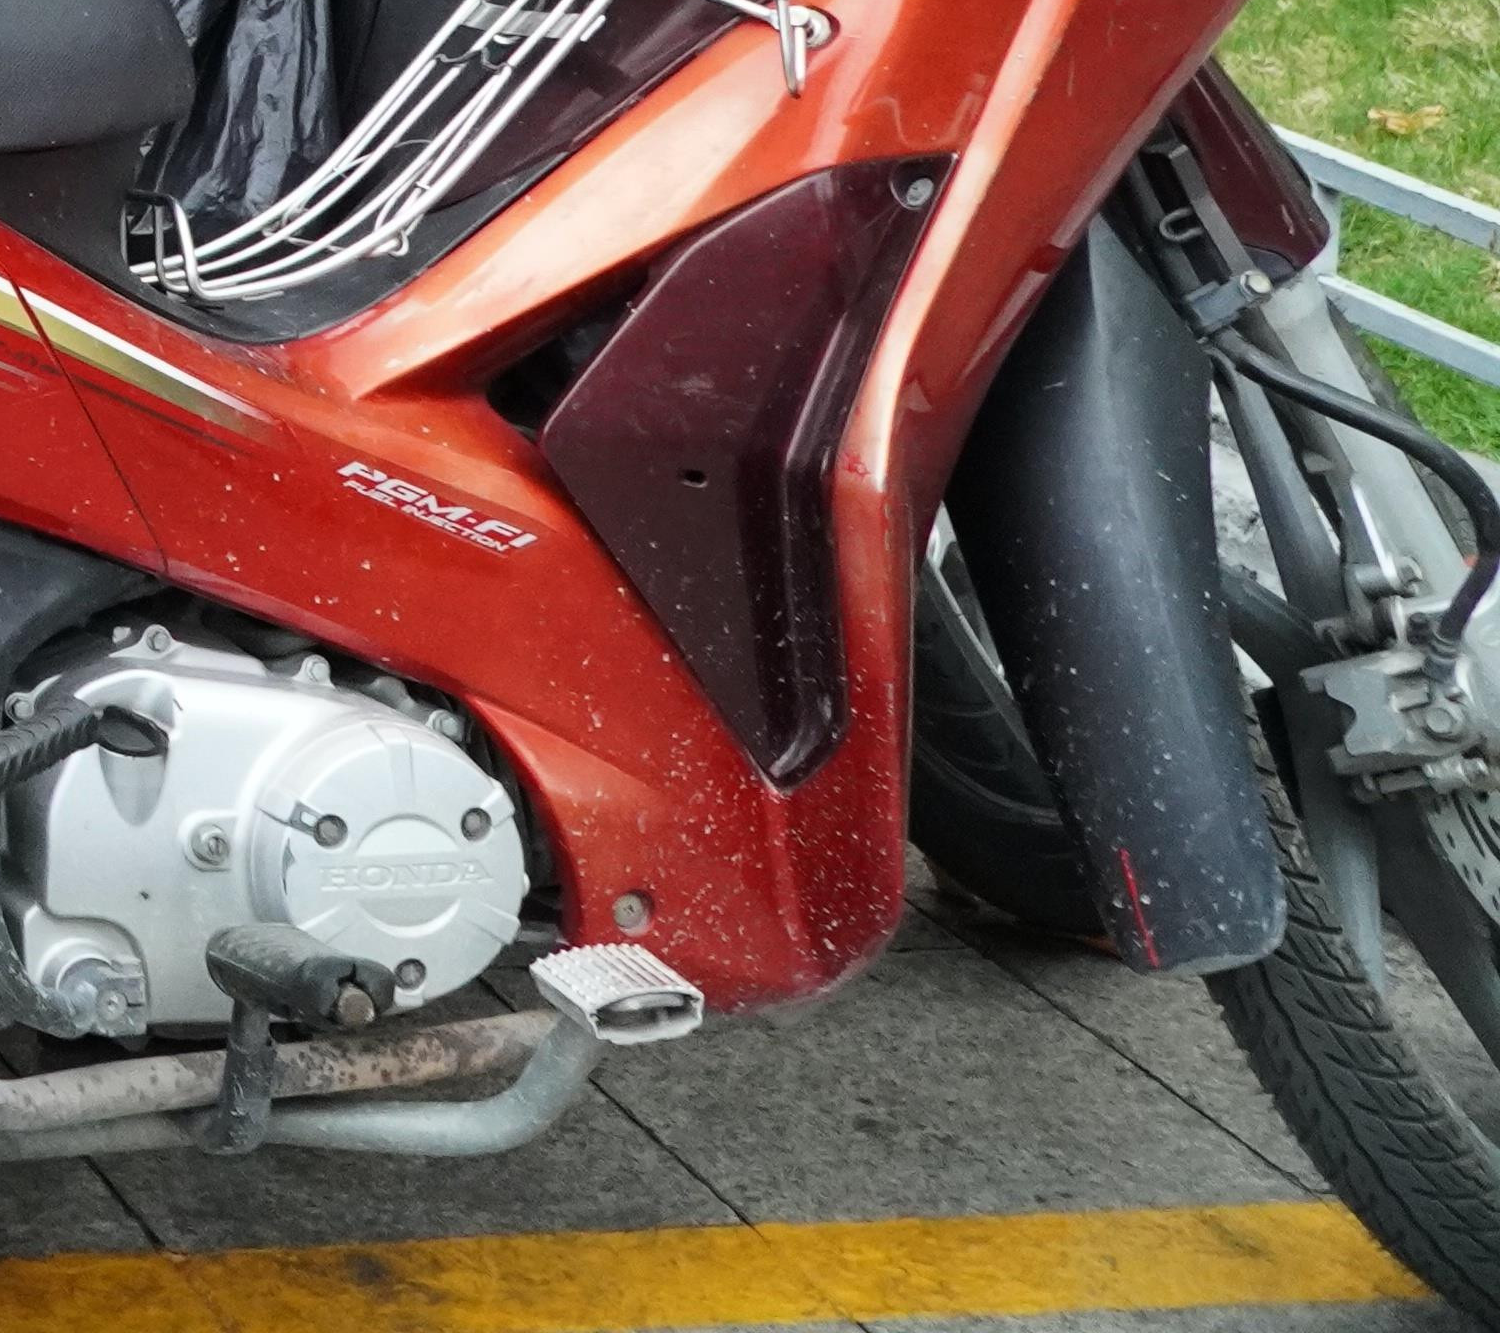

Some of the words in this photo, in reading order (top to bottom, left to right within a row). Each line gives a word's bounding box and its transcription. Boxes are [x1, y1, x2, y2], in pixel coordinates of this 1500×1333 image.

[342, 479, 397, 508] FUEL
[400, 504, 508, 552] INJECTION
[320, 859, 495, 892] HONDA
